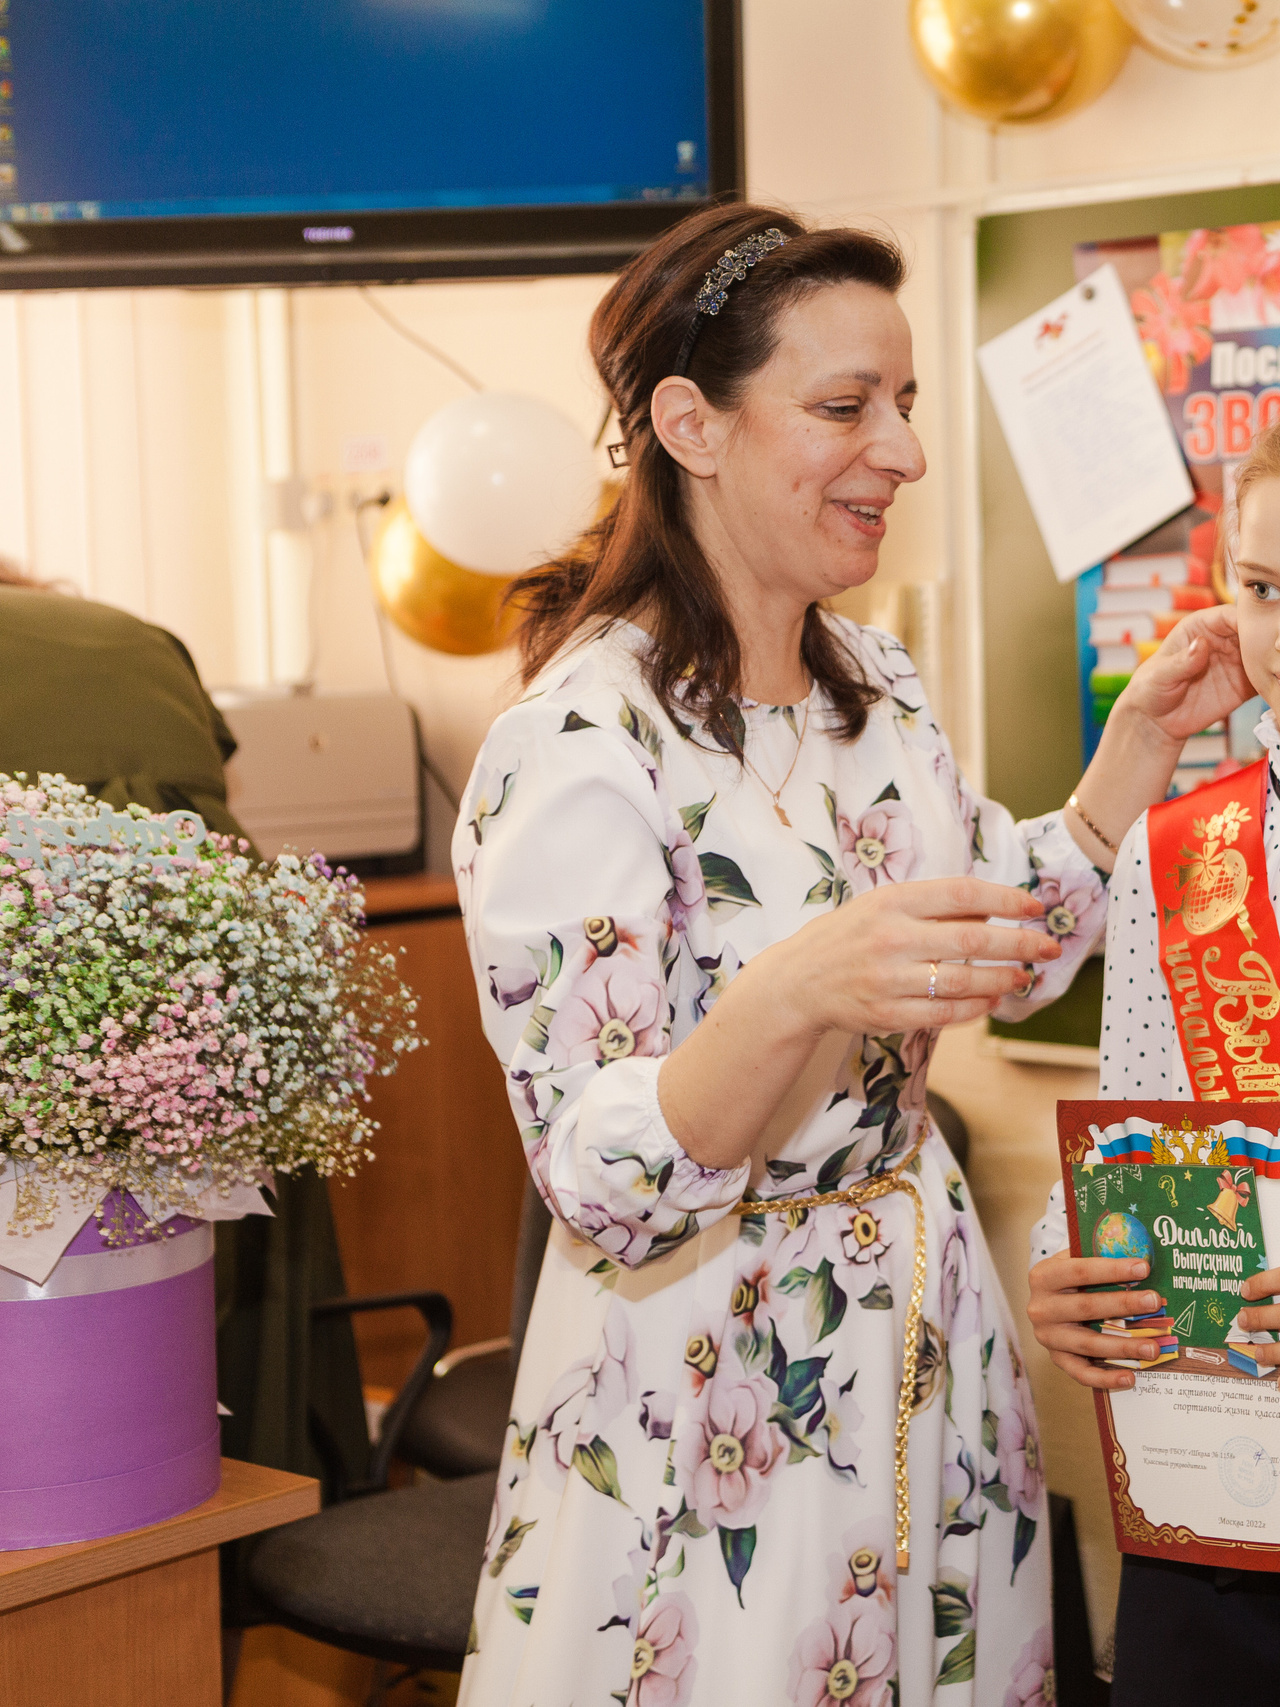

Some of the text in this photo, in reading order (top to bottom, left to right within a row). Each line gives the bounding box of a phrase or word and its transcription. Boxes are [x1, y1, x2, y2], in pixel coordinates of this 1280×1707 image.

[1153, 1214, 1257, 1250] Диплом
[1172, 1248, 1243, 1277] Выпускника
[1172, 1274, 1218, 1293] начальной
[1134, 1370, 1170, 1381] тарание
[1180, 1372, 1229, 1385] достижение
[1164, 1387, 1173, 1395] за
[1177, 1388, 1217, 1399] активное
[1220, 1391, 1253, 1402] участие
[1172, 1403, 1280, 1420] спортивной жизни класса
[1218, 1516, 1244, 1528] Москва
